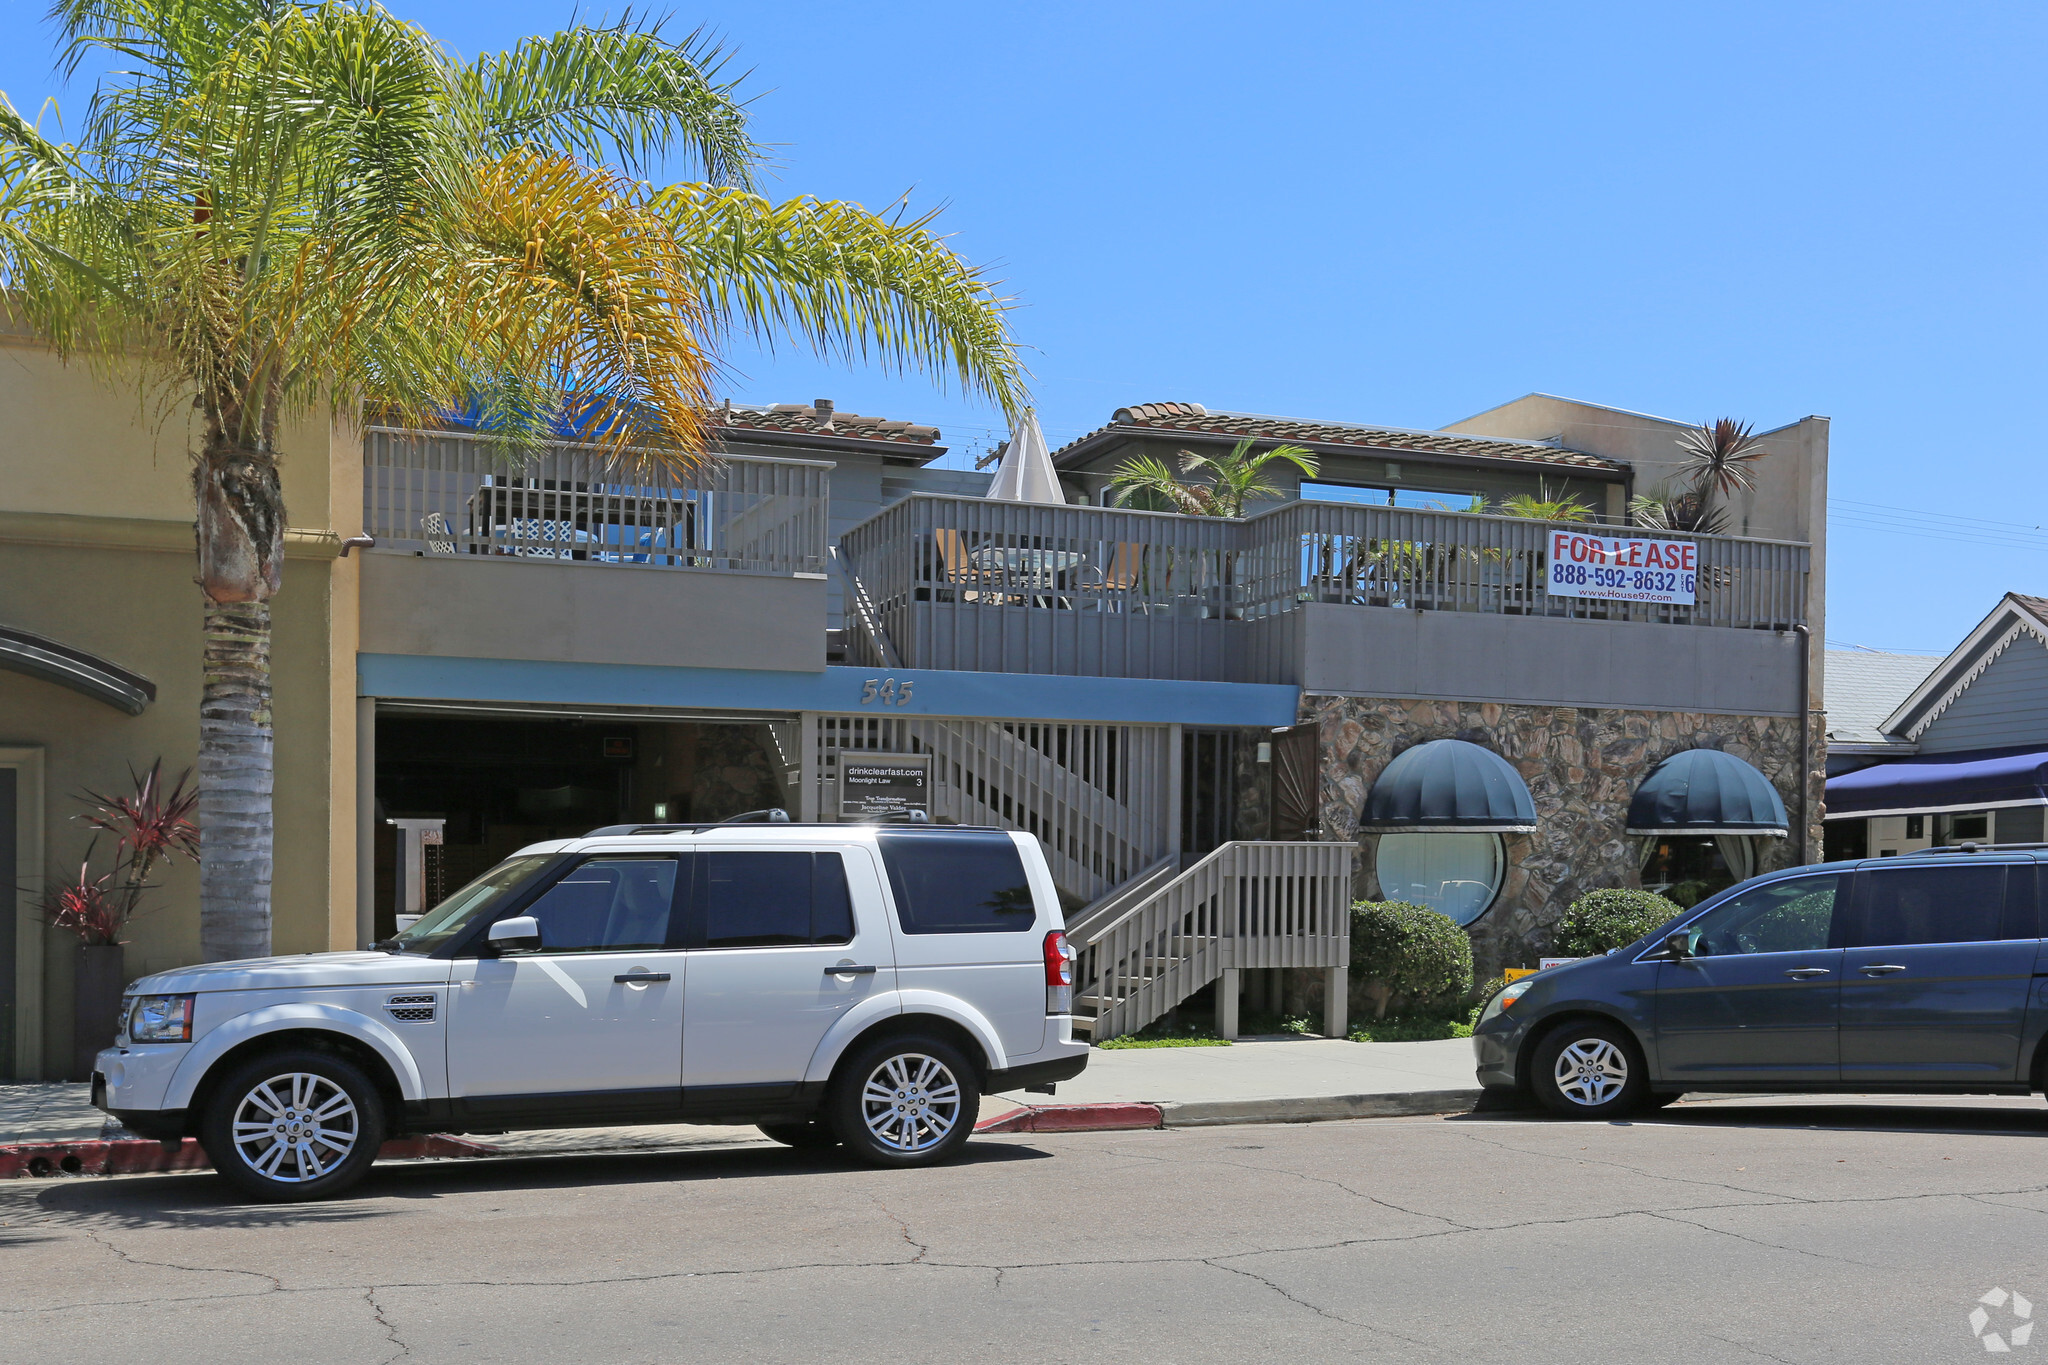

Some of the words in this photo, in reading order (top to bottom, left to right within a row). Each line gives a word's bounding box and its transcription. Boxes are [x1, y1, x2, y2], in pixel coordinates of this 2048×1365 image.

[1554, 534, 1606, 564] FOR
[1614, 542, 1695, 570] LEASE
[1553, 564, 1676, 592] 888-592-8632
[1685, 574, 1695, 593] 6
[1579, 590, 1672, 601] www.House97.com
[861, 677, 914, 707] 545
[849, 768, 923, 776] drinkclearfast.com
[916, 778, 923, 787] 3
